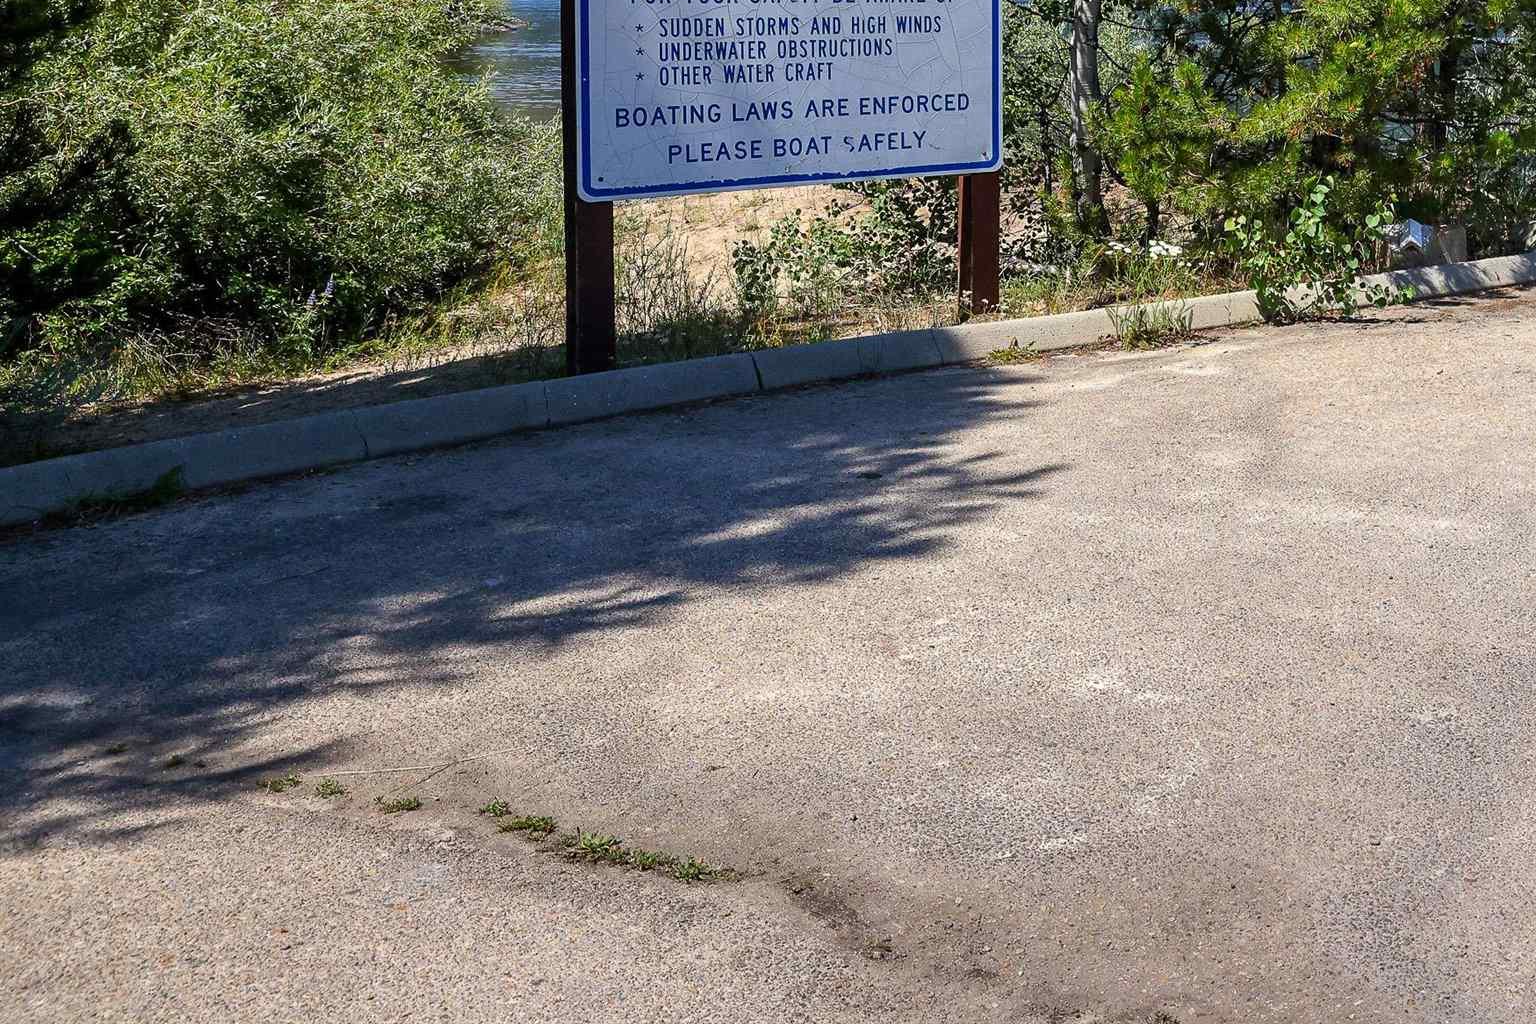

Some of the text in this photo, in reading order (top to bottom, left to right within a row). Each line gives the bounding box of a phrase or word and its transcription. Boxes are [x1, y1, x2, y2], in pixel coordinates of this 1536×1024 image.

[659, 15, 942, 38] SUDDEN STORMS AND HIGH WINDS
[659, 38, 893, 62] UNDERWATER OBSTRUCTIONS
[659, 62, 833, 86] OTHER WATER CRAFT
[615, 93, 970, 128] BOATING LAWS ARE ENFORCED
[668, 130, 927, 164] PLEASE BOAT SAFELY
